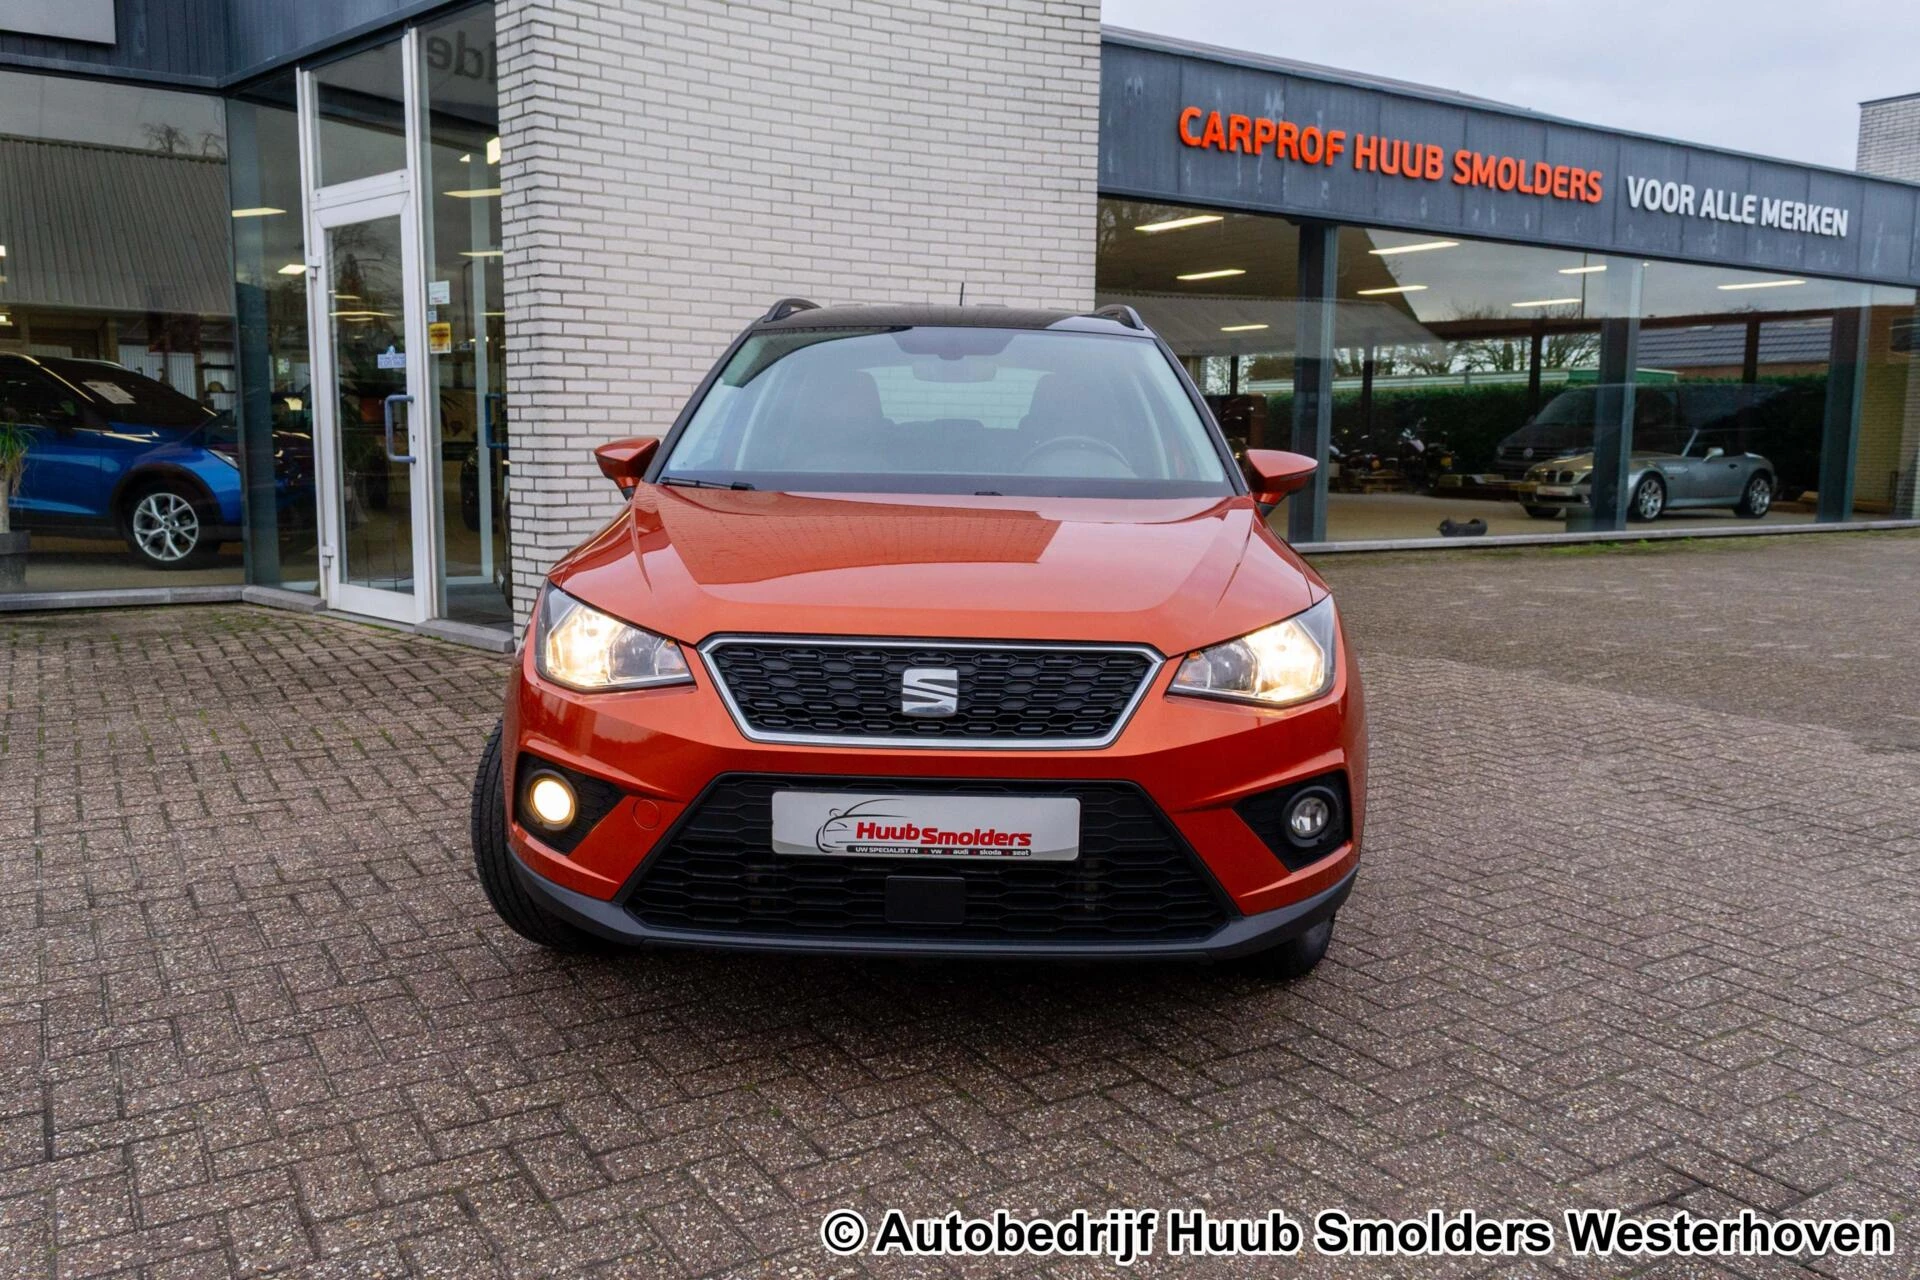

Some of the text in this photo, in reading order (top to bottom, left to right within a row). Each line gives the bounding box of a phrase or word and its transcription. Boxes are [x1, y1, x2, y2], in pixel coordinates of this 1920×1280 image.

[1178, 106, 1603, 204] CARPROF HUUB SMOLDERS
[1626, 175, 1849, 238] VOOR ALLE MERKEN
[868, 846, 910, 854] SPECIALIST
[979, 848, 1002, 856] skoda
[1012, 849, 1029, 857] seat
